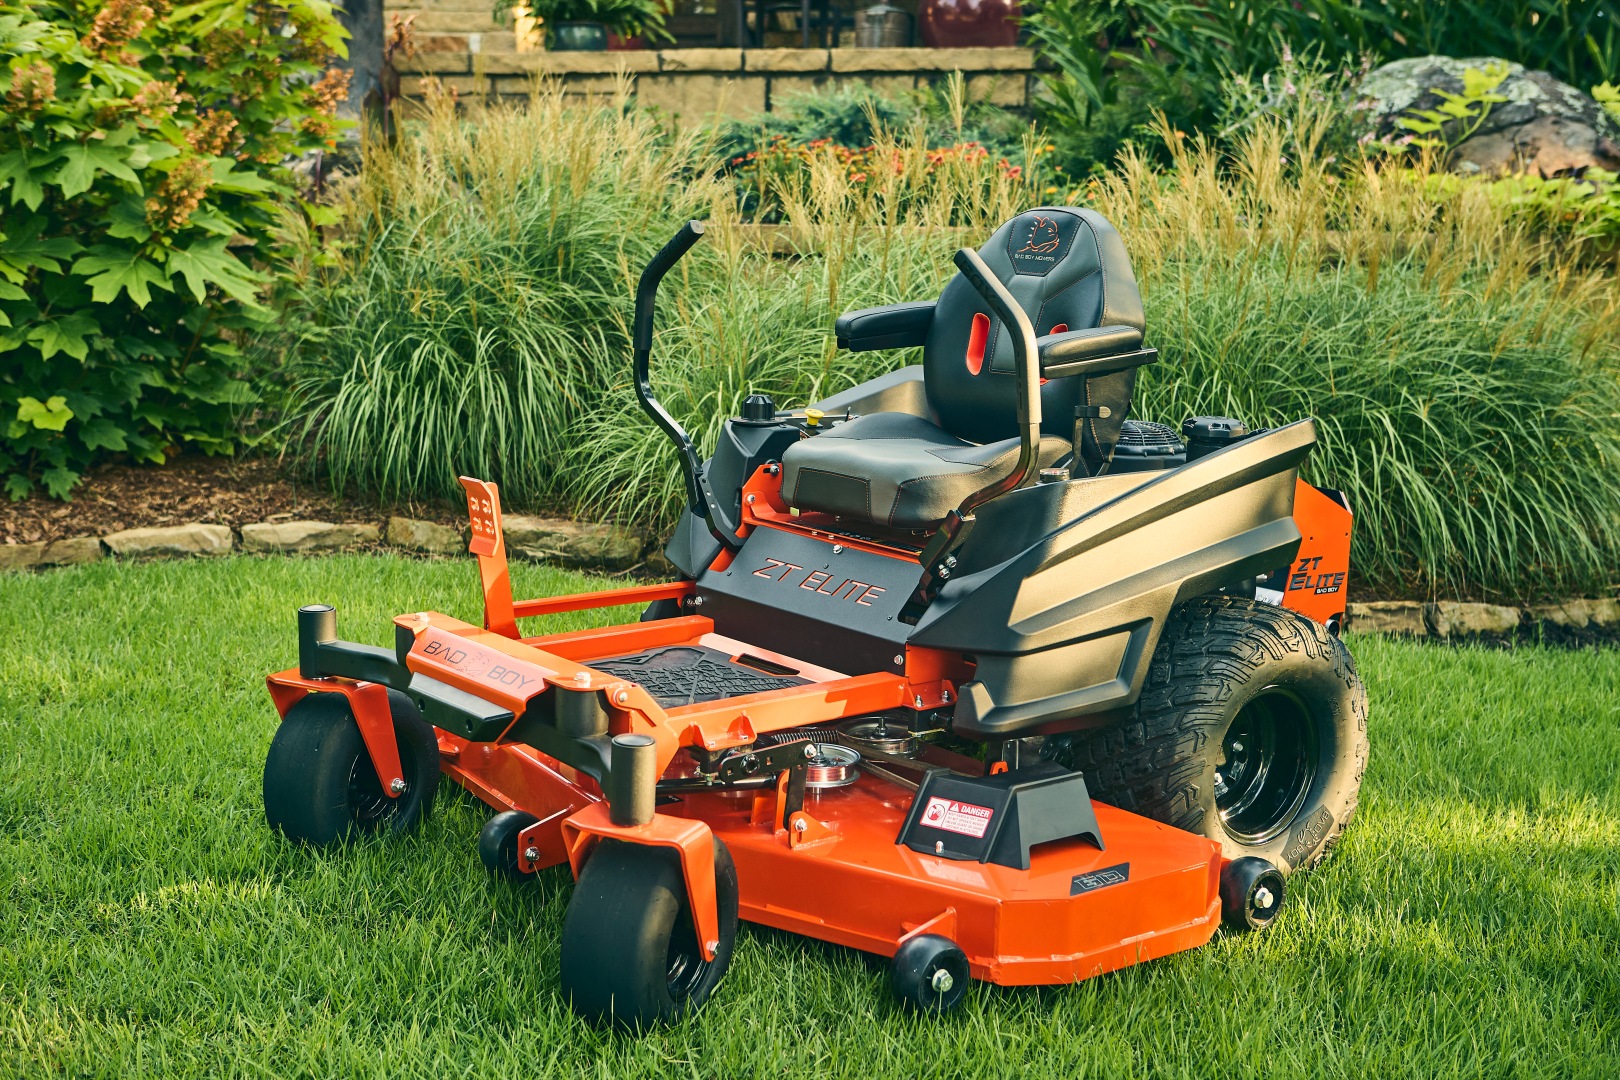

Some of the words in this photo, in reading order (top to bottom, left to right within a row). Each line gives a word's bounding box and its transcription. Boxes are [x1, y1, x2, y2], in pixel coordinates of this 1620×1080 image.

[1298, 556, 1323, 572] ZT
[752, 557, 803, 582] ZT
[798, 570, 887, 607] ELITE
[1288, 572, 1346, 591] ELITE
[423, 640, 467, 665] BAD
[486, 665, 536, 690] BOY
[961, 805, 990, 818] DANGER
[1287, 845, 1304, 861] BOY
